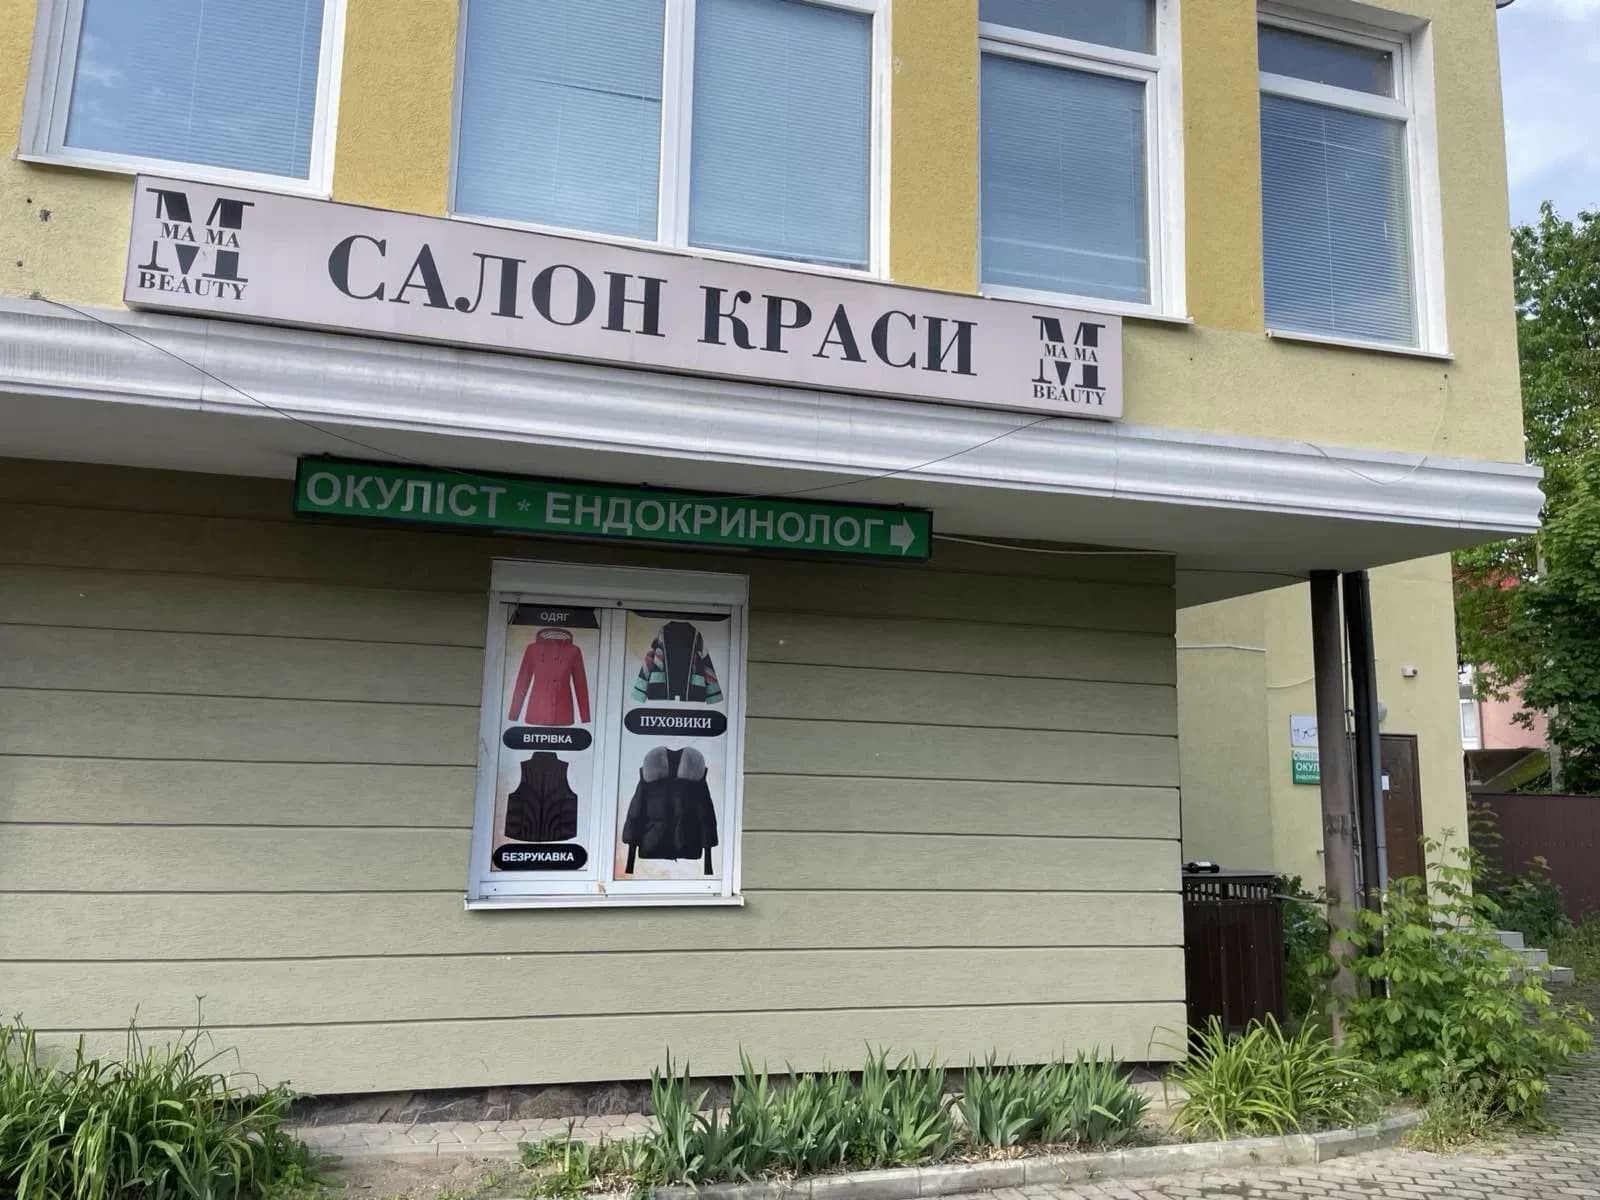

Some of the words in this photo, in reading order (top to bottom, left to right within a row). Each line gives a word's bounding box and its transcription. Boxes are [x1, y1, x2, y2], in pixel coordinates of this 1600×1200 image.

[137, 271, 248, 301] BEAUTY
[328, 233, 668, 338] САЛОН
[697, 284, 978, 377] КРАСИ
[1033, 384, 1106, 405] BEAUTY
[306, 471, 507, 519] ОКУЛІСТ
[544, 492, 884, 548] ЕНДОКРИНОЛОГ
[540, 611, 570, 622] ОДЯГ
[639, 715, 712, 729] ПУХОВИКИ
[522, 733, 573, 744] ВІТРІВКА
[501, 851, 575, 863] БЕЗРУКАВКА
